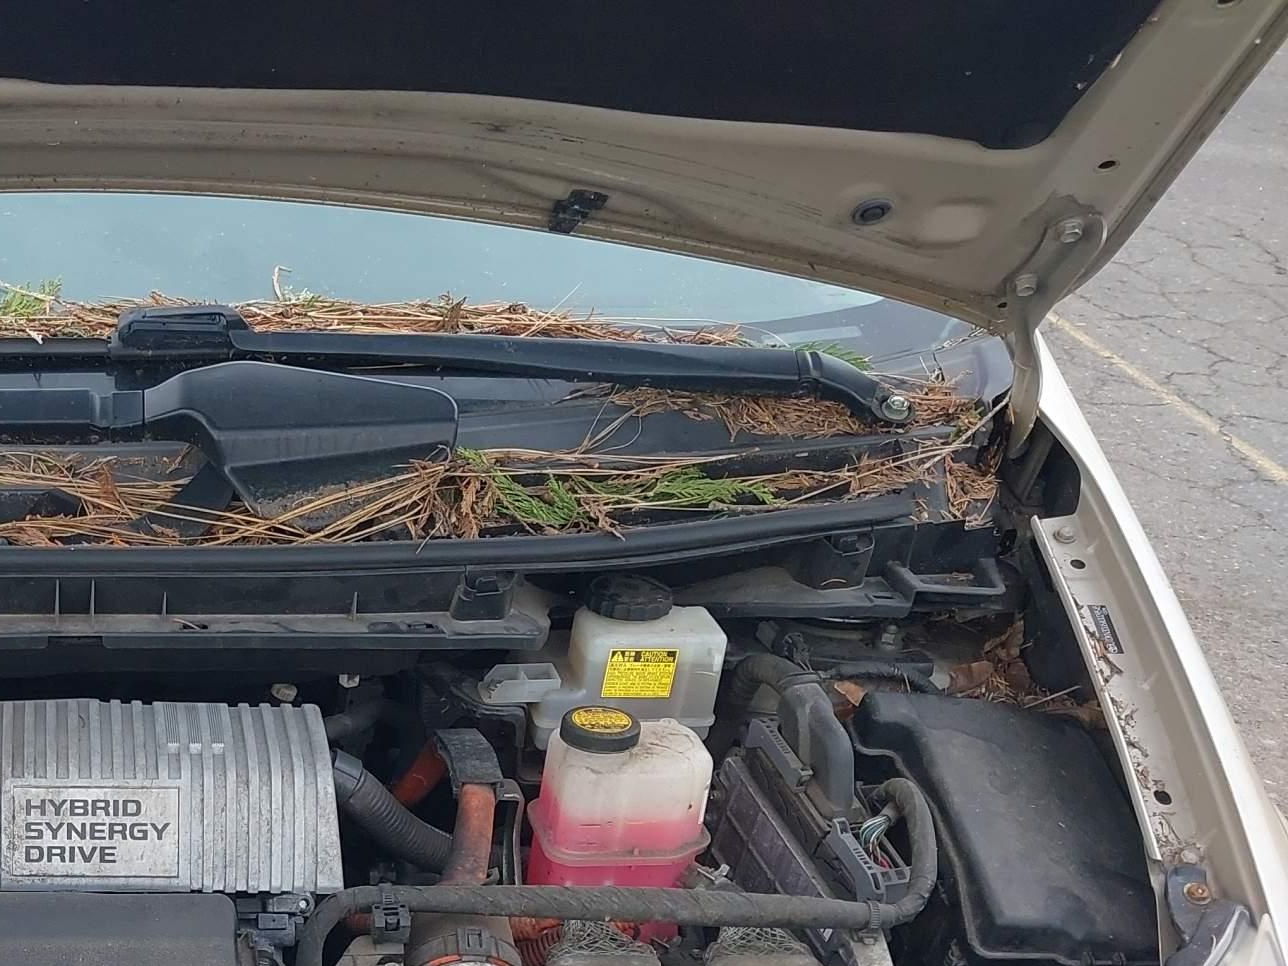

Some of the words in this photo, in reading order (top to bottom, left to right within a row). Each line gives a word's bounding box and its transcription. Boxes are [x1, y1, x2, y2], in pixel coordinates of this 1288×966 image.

[25, 799, 142, 817] HYBRID
[24, 822, 172, 841] SYNERGY
[24, 846, 118, 864] DRIVE
